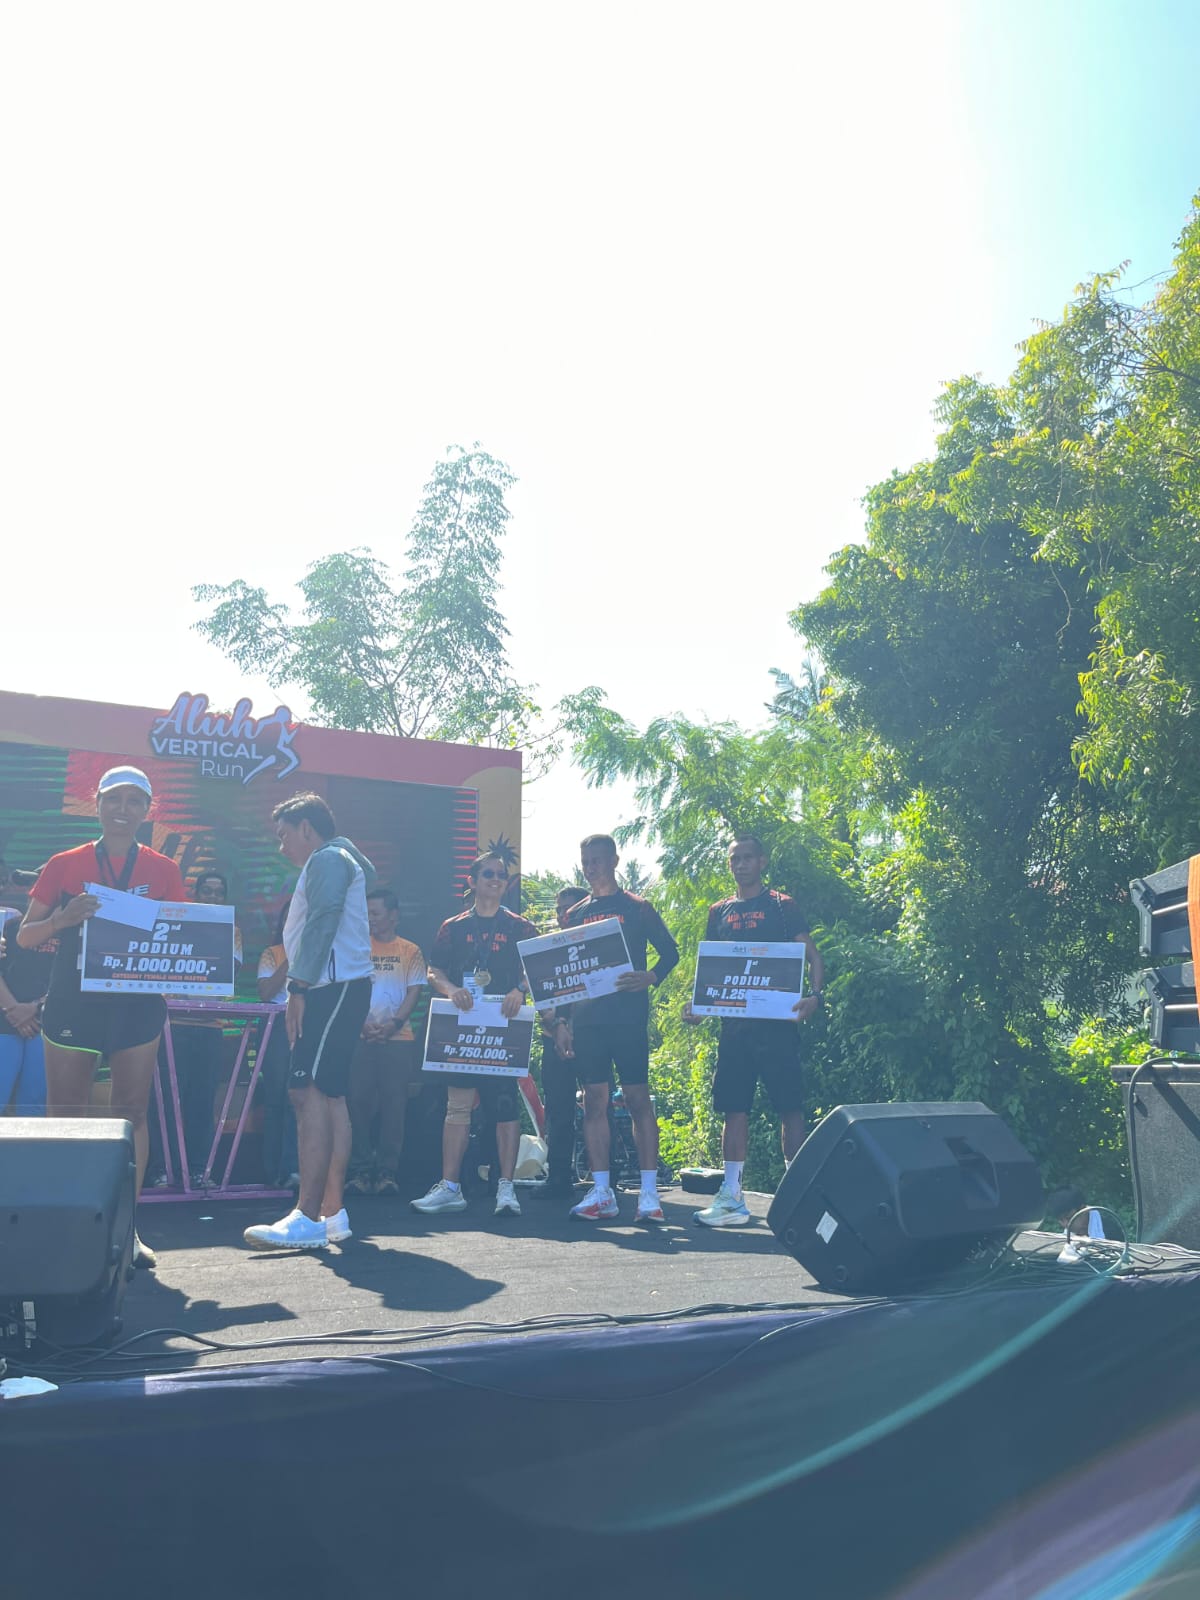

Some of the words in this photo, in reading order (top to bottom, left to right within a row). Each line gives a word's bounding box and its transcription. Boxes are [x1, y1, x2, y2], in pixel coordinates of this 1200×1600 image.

[153, 695, 258, 739] Aluh
[152, 737, 263, 759] VERTICAL
[202, 760, 244, 777] Run
[153, 922, 182, 941] 2nd
[128, 941, 194, 956] PODIUM
[555, 957, 599, 976] PODIUM
[723, 975, 771, 986] PODIUM
[457, 1034, 504, 1046] PODIUM
